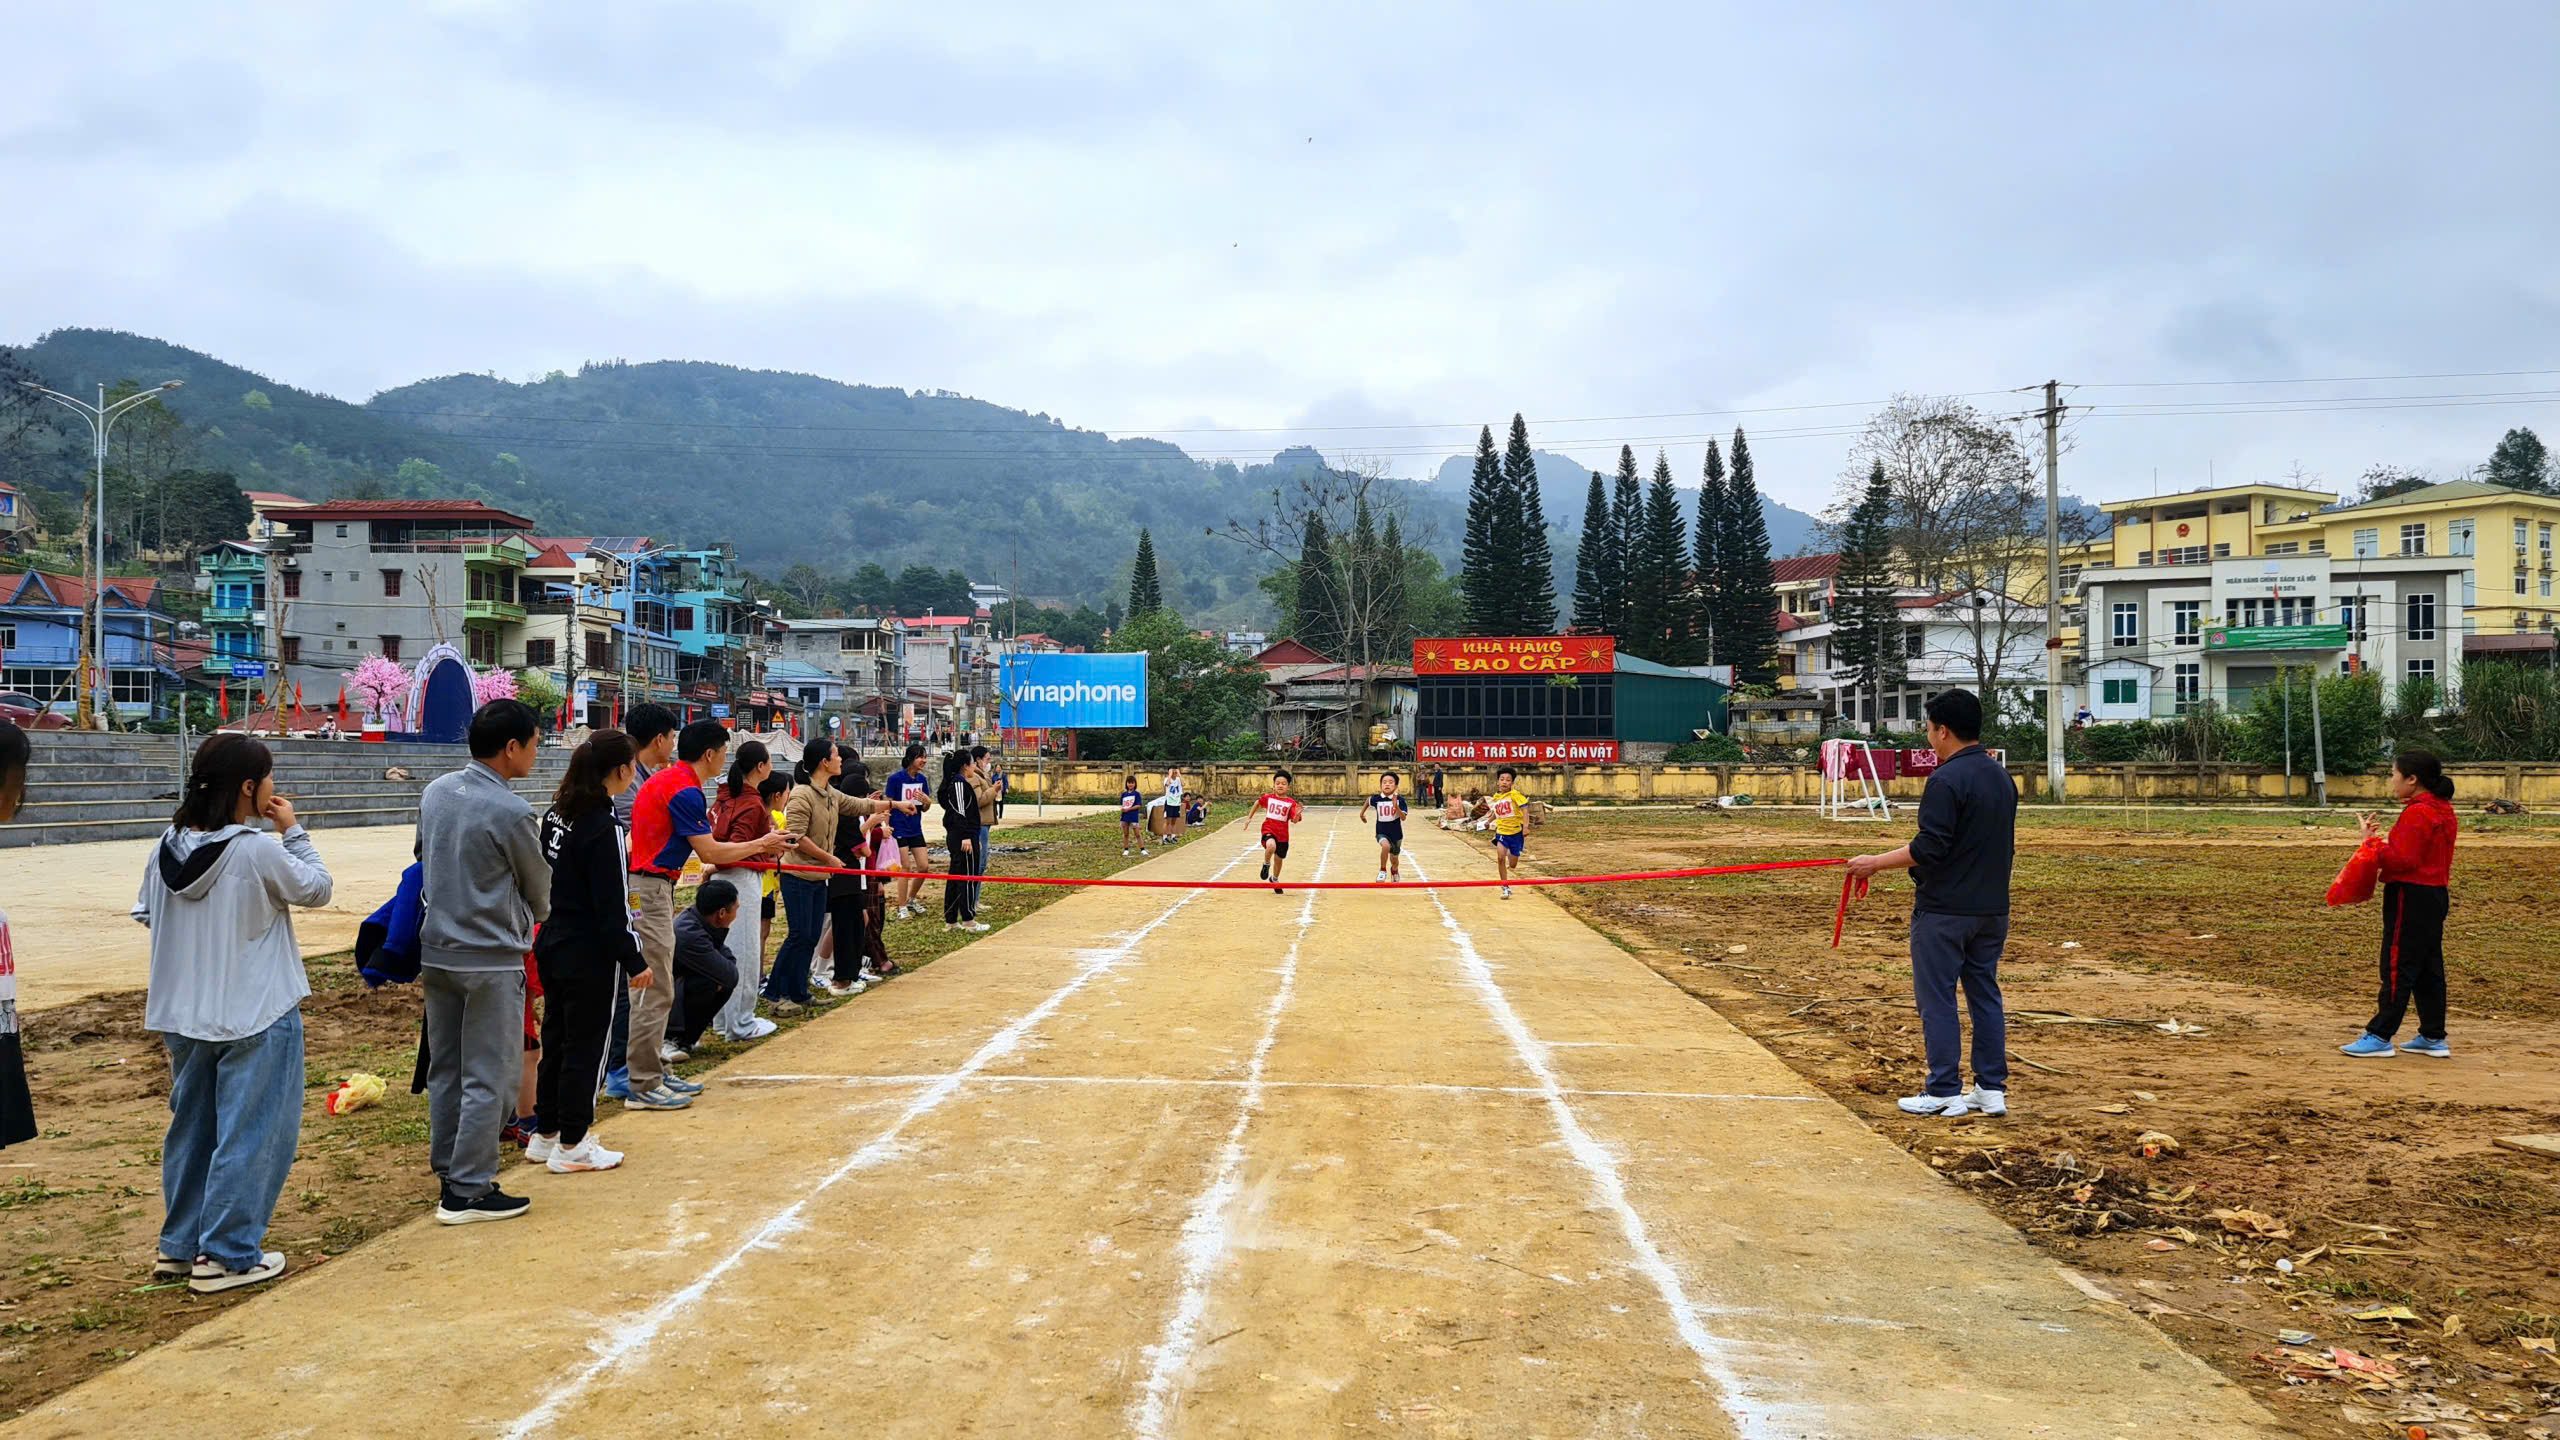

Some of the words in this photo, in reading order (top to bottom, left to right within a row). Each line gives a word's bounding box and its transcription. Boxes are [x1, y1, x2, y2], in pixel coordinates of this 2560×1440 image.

[1463, 640, 1504, 654] NHÀ
[1509, 640, 1563, 654] HÀNG
[1449, 658, 1511, 671] BAO
[1519, 654, 1576, 671] CẤP
[1009, 680, 1137, 707] vinaphone
[1422, 742, 1448, 758] BÚN
[1451, 742, 1475, 758] CHẢ
[1483, 743, 1507, 758] TRÀ
[1511, 743, 1537, 758] SỮA
[1570, 743, 1587, 758] ĂN
[1589, 743, 1613, 762] VẶT
[1269, 803, 1289, 817] 059
